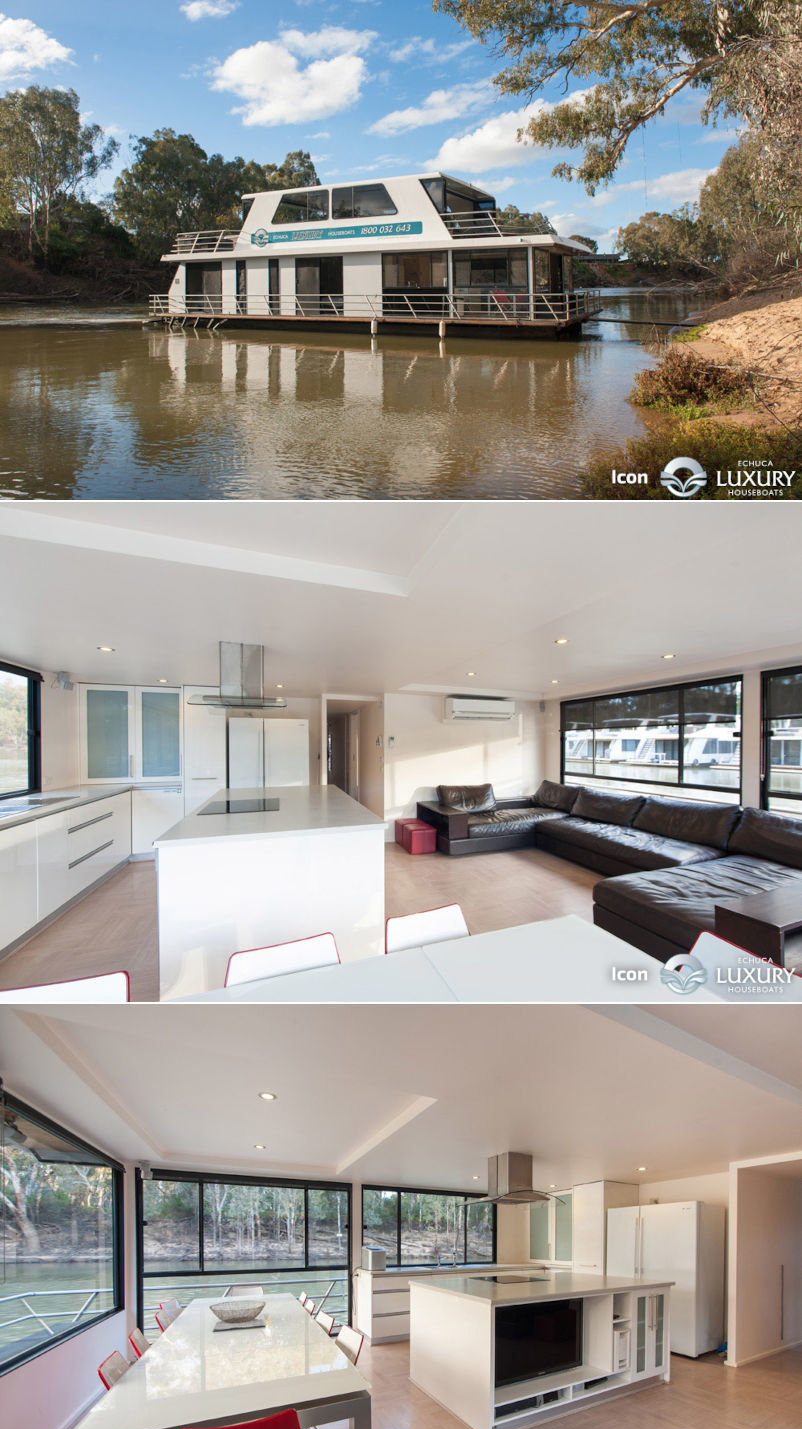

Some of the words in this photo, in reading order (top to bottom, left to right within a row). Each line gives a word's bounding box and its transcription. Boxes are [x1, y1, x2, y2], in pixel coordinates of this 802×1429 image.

[292, 230, 323, 240] LUXURY
[360, 226, 378, 235] 1800
[379, 225, 393, 234] 032
[395, 223, 411, 233] 643
